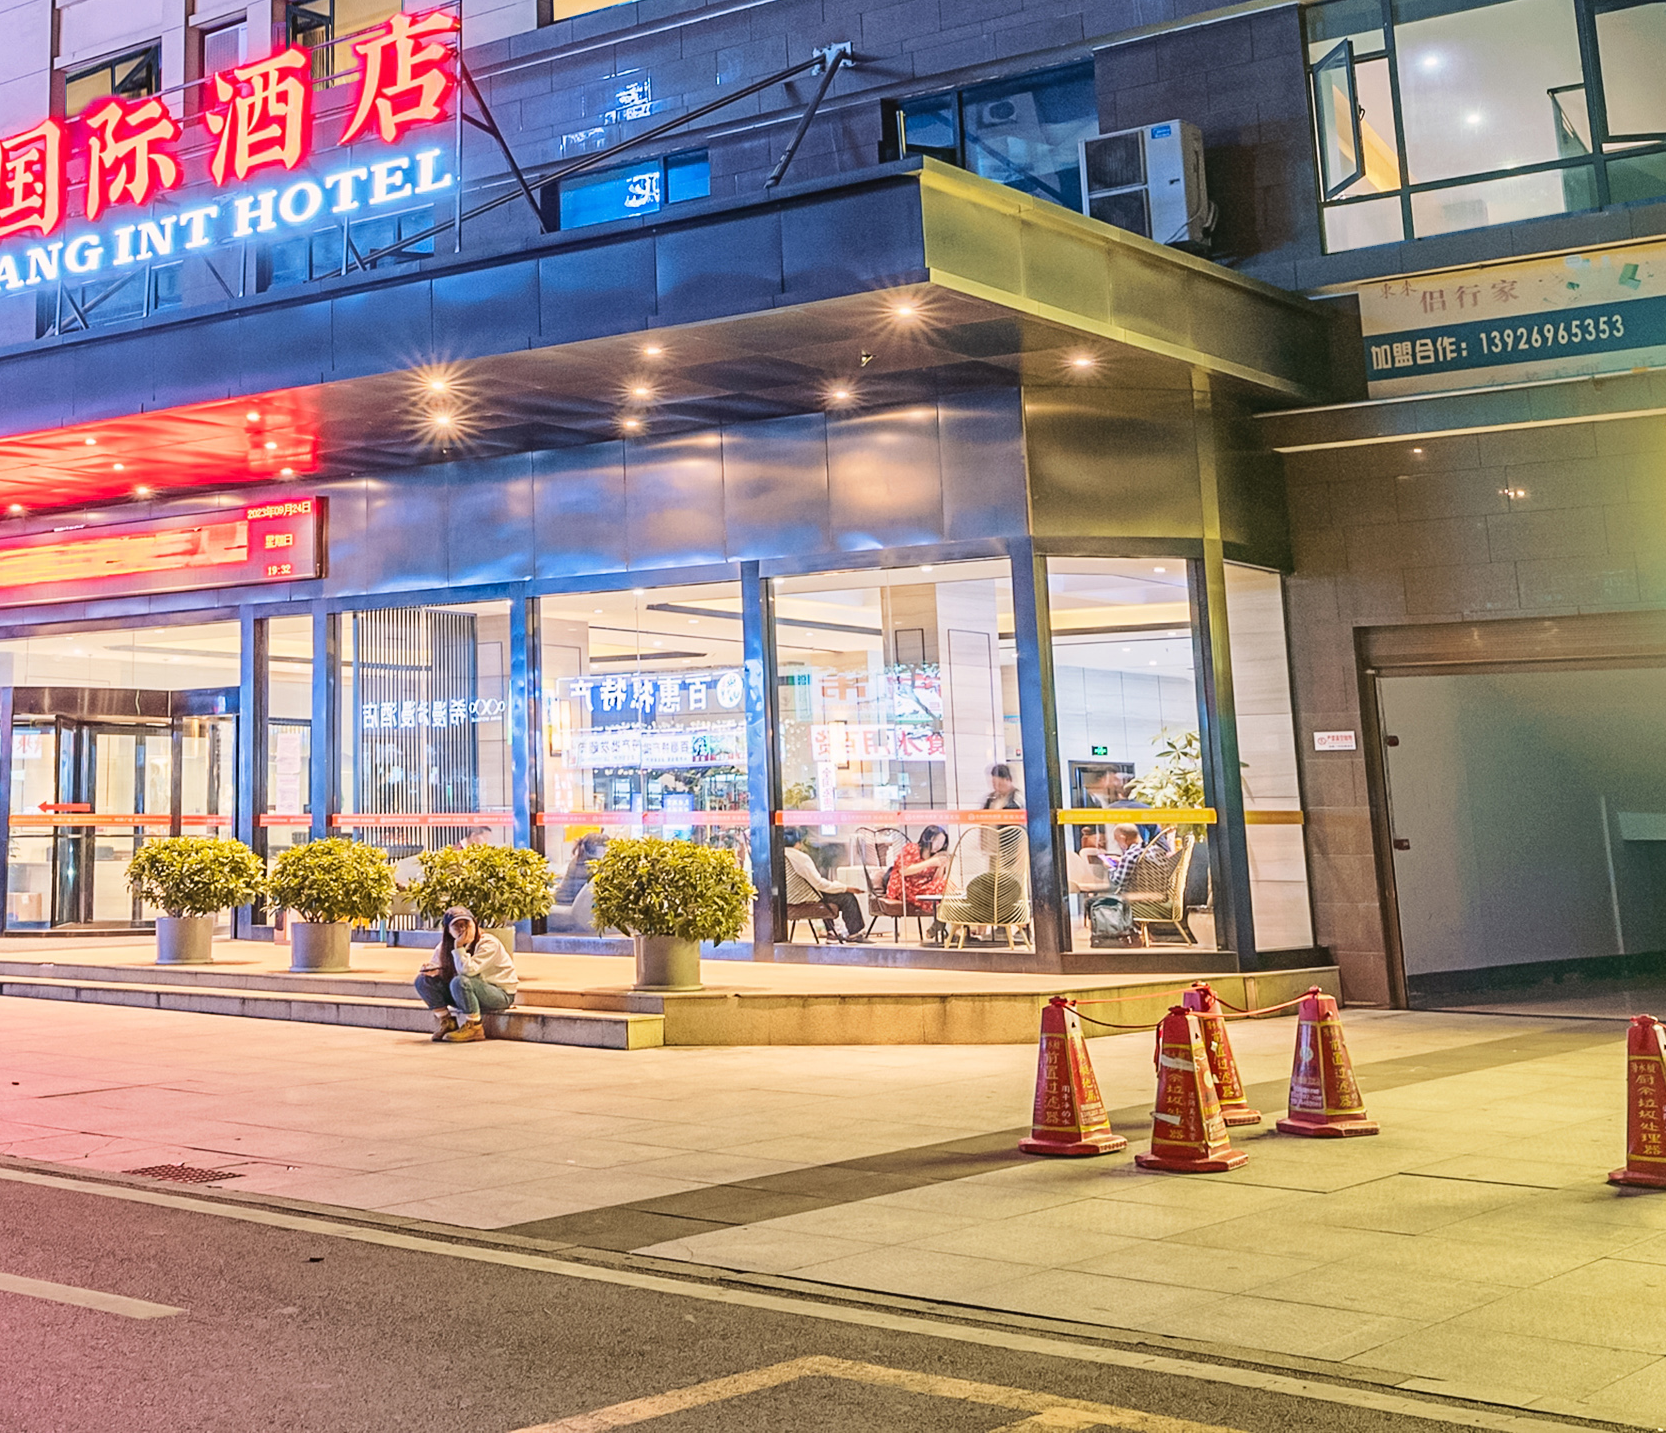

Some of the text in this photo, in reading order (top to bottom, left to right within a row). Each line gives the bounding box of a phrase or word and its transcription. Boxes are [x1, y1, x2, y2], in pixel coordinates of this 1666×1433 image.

[111, 207, 220, 267] INT
[233, 148, 454, 240] HOTEL
[1420, 279, 1520, 314] 侣行家
[1370, 313, 1626, 371] 加盟合作： 13926965353
[247, 501, 311, 520] 2023年09月24日
[267, 563, 292, 576] 19:32
